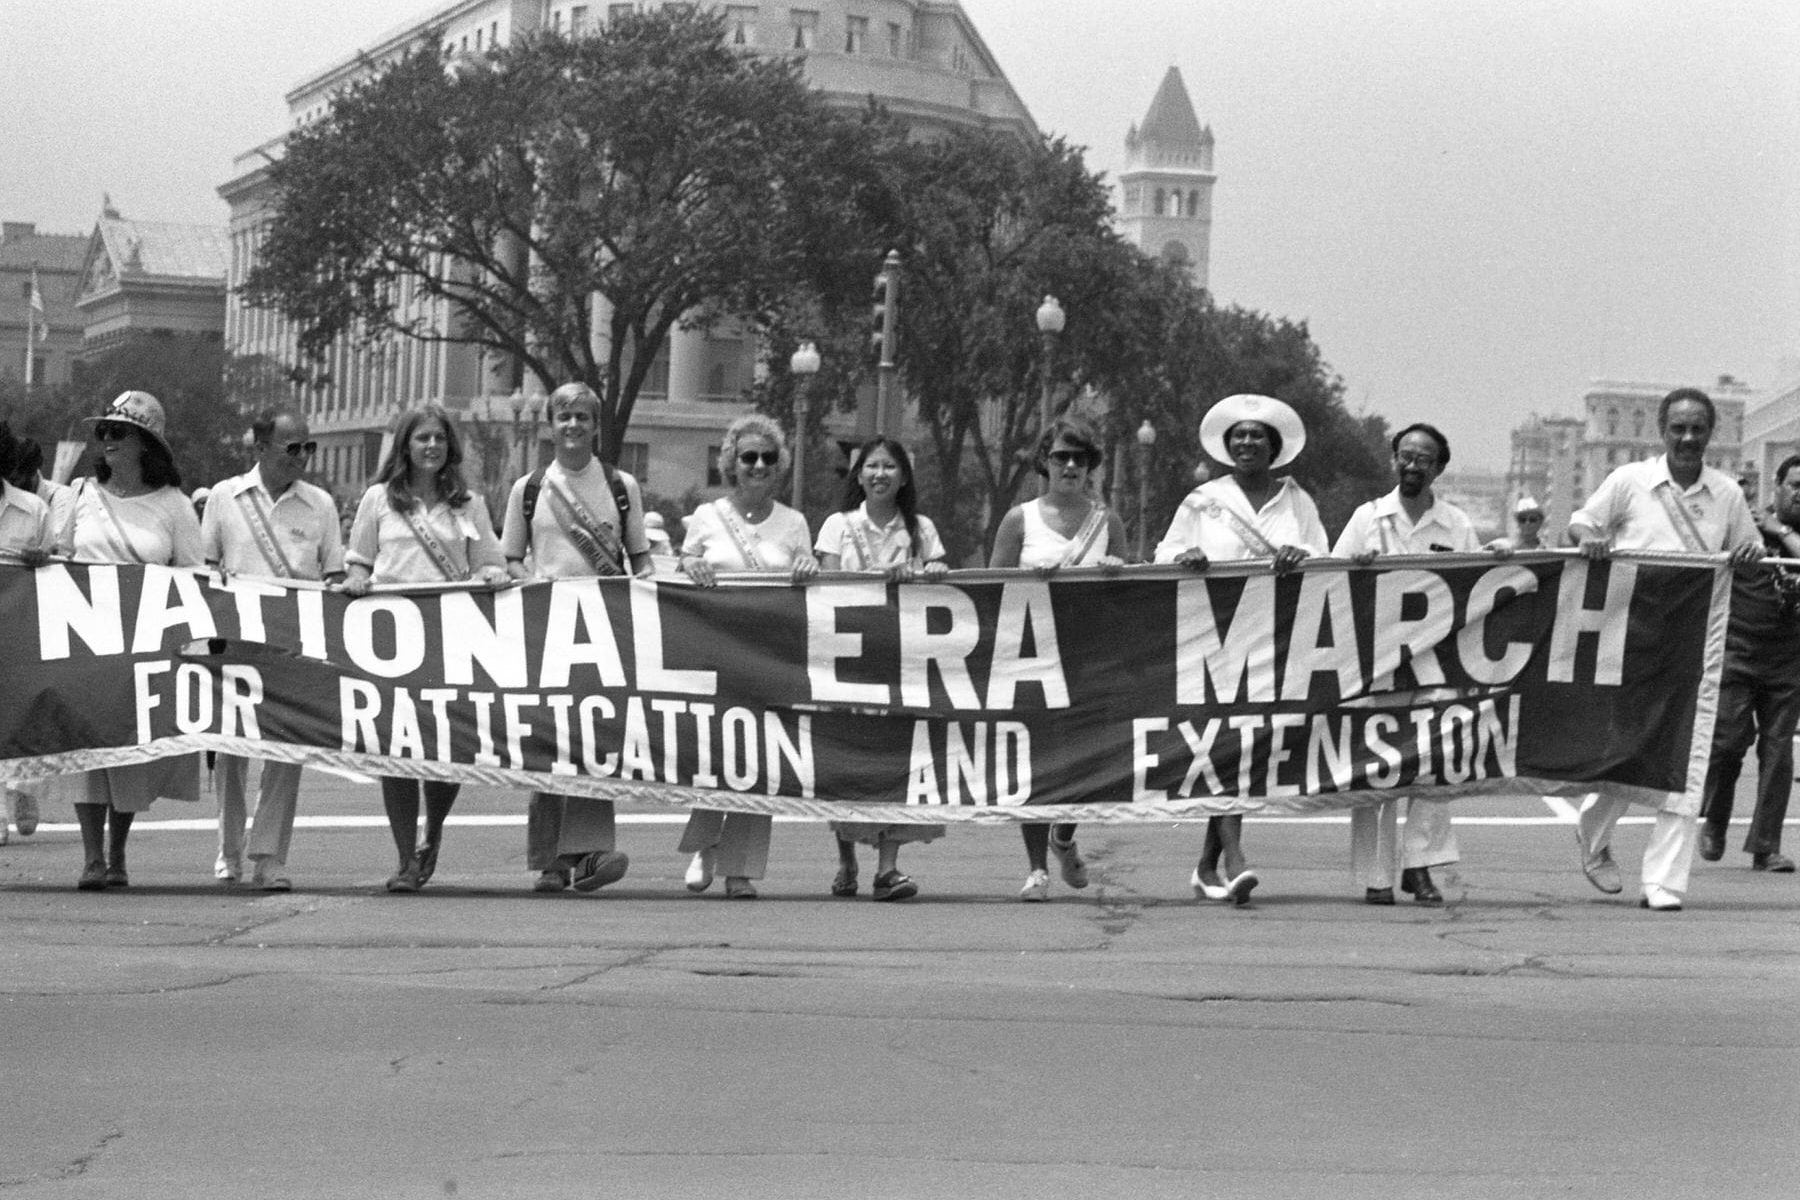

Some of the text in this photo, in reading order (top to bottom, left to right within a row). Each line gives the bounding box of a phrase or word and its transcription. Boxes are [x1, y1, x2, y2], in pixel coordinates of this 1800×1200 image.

[36, 558, 1639, 710] NATIONAL ERA MARCH
[134, 660, 1521, 808] FOR RATIFICATION AND EXTENSION
